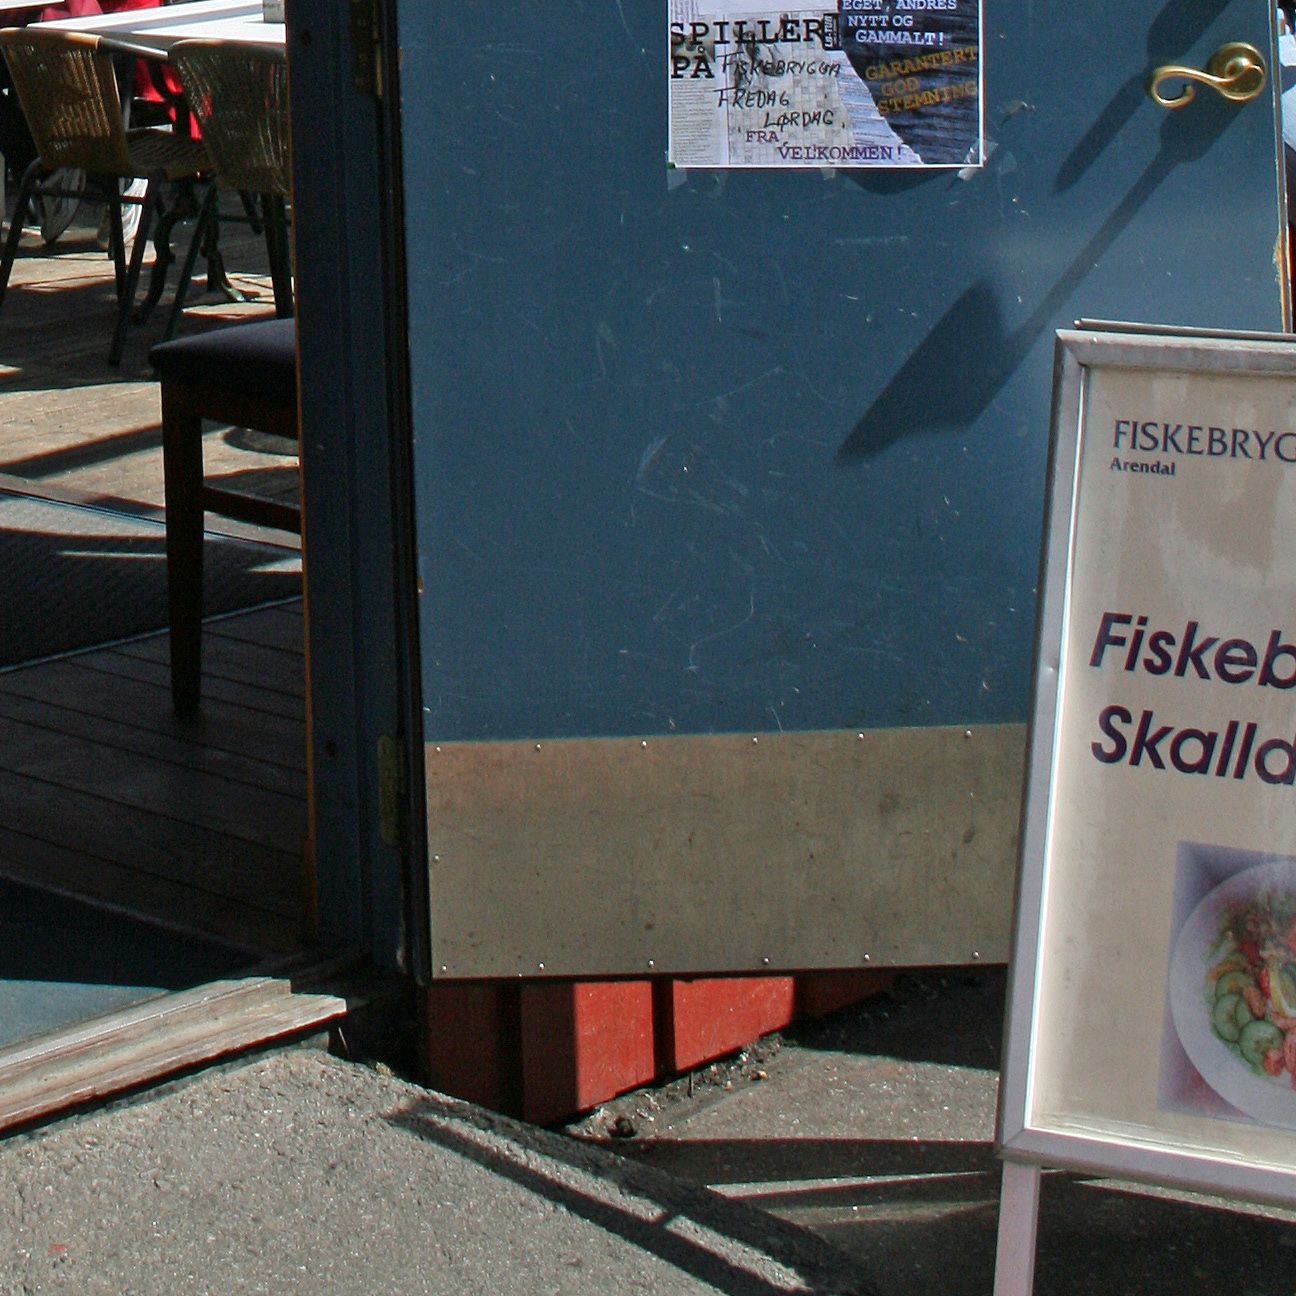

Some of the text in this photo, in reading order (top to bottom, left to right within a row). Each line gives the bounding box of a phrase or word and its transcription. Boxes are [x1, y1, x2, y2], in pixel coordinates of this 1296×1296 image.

[670, 19, 824, 45] SPILLER
[848, 15, 914, 27] NYTT OG
[855, 29, 945, 47] GAMMALT!
[670, 45, 716, 79] PÅ
[864, 45, 978, 81] GARANTERT
[713, 86, 790, 109] FREDAG
[877, 80, 977, 115] STEMNING
[881, 76, 919, 96] GOD
[764, 110, 835, 134] LØRDAG
[745, 130, 780, 143] FRA
[778, 143, 902, 160] VELKOMMEN!
[1110, 456, 1176, 476] Arendal
[1089, 611, 1296, 689] Fiskeb
